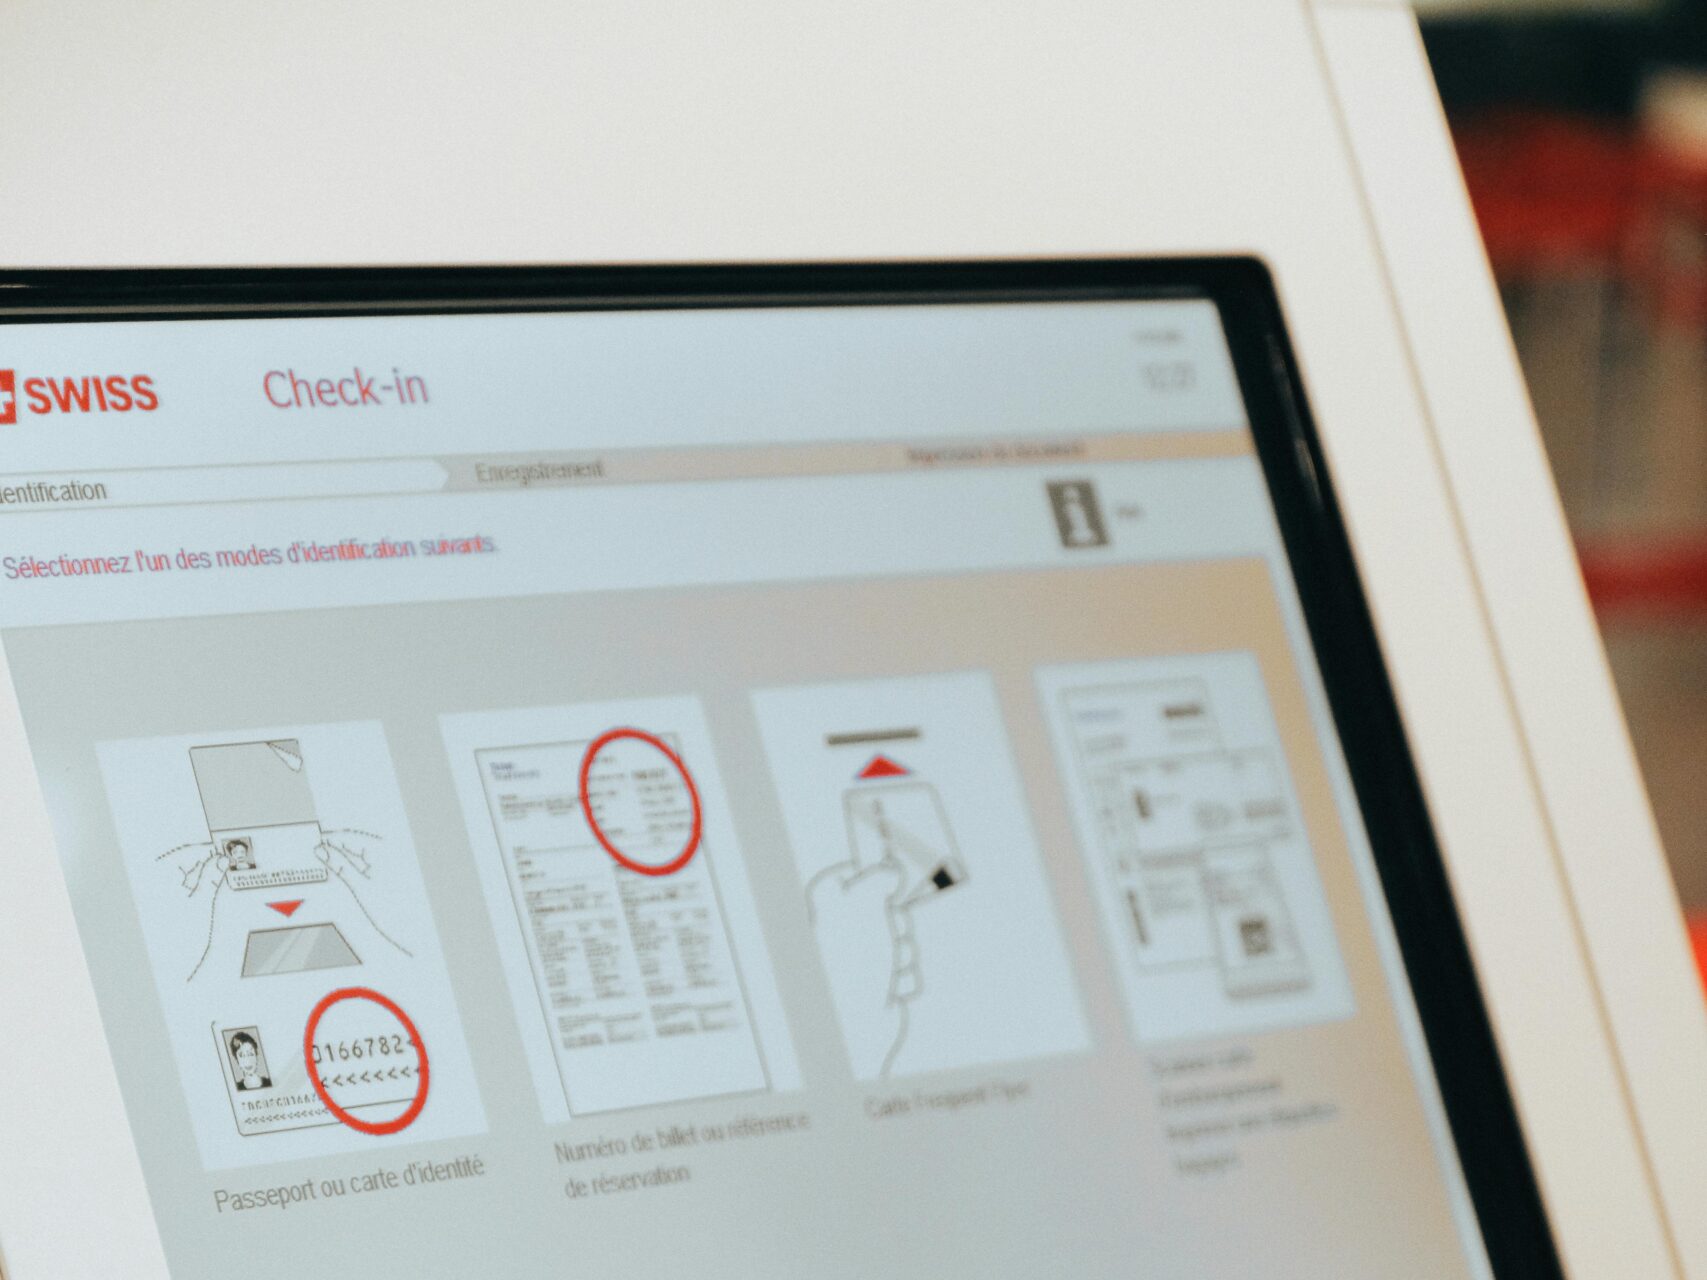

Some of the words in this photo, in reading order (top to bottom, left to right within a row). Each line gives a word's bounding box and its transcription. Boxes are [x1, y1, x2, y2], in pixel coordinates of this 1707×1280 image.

[23, 374, 159, 415] SWISS
[263, 366, 430, 408] Check-in
[3, 553, 132, 580] Sélectionnez
[135, 549, 171, 572] l'un
[175, 547, 212, 570] des
[217, 543, 283, 568] modes
[286, 537, 416, 564] d'identification
[553, 1134, 628, 1165] Numéro
[630, 1129, 654, 1153] de
[656, 1121, 698, 1150] billet
[700, 1122, 726, 1143] ou
[213, 1178, 317, 1214] Passeport
[321, 1177, 346, 1199] ou
[349, 1167, 399, 1194] carte
[402, 1153, 486, 1186] d'identité
[564, 1176, 589, 1200] de
[591, 1164, 691, 1194] réservation
